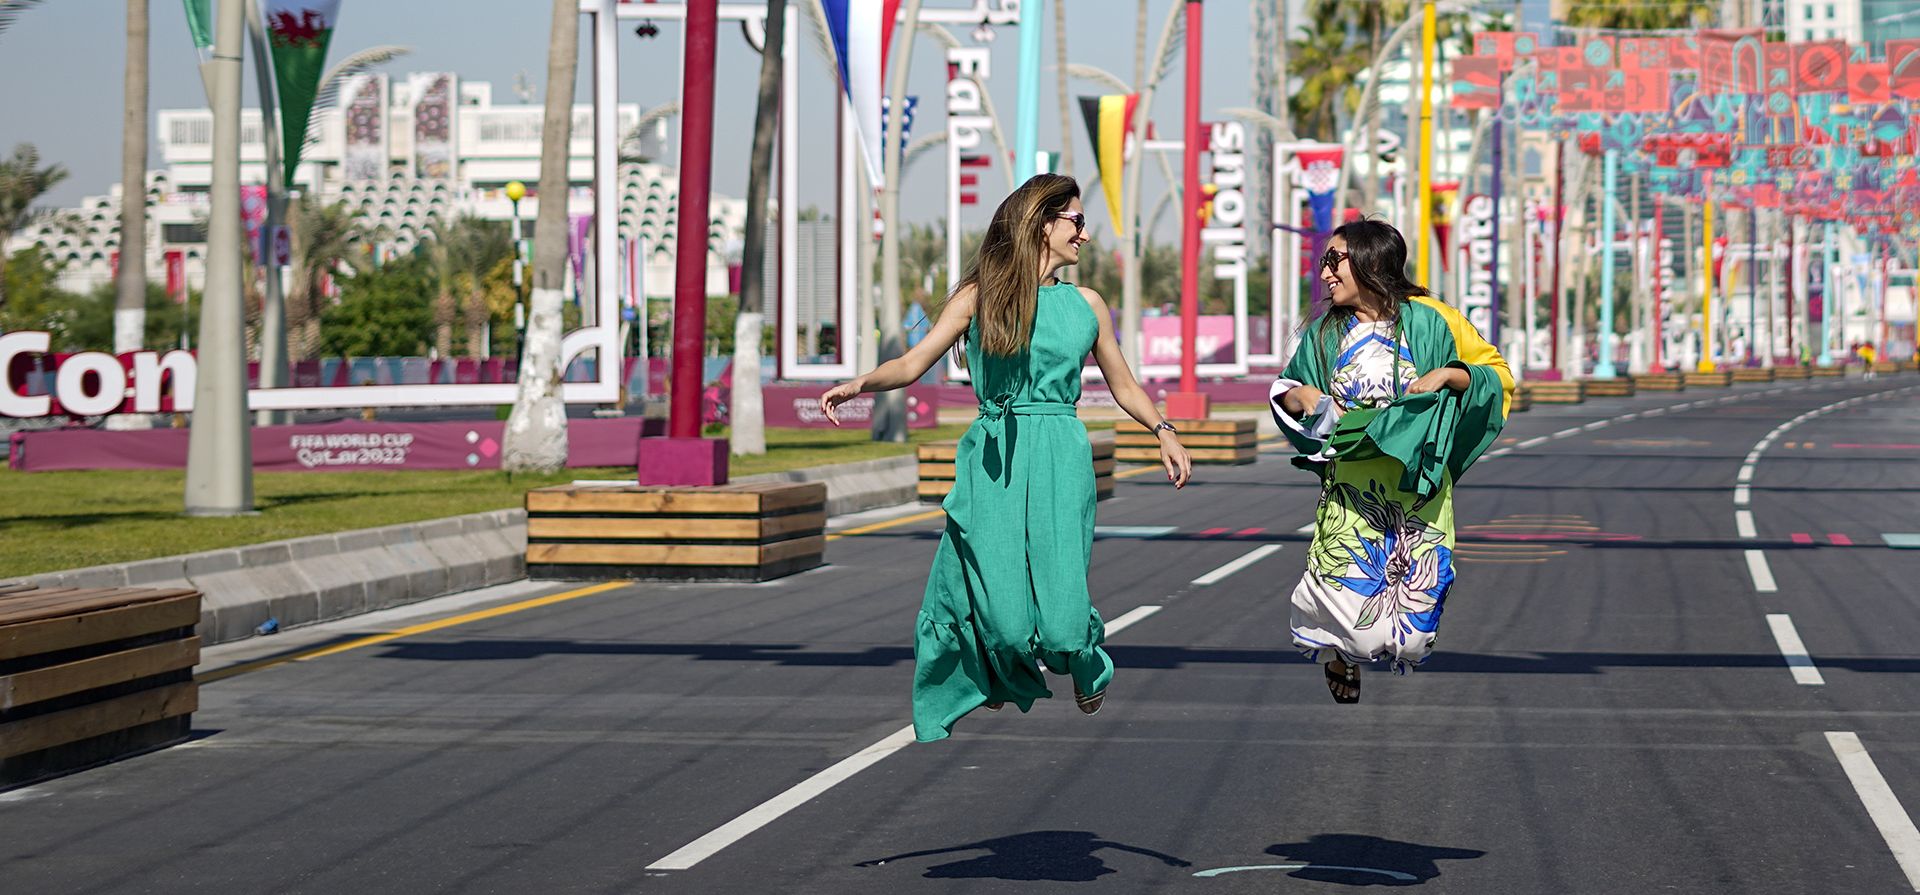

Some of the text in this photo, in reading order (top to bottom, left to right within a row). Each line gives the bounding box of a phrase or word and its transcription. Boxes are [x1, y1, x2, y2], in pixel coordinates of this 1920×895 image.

[1201, 121, 1247, 279] ulous
[290, 432, 413, 449] FIFA WORLD CUP
